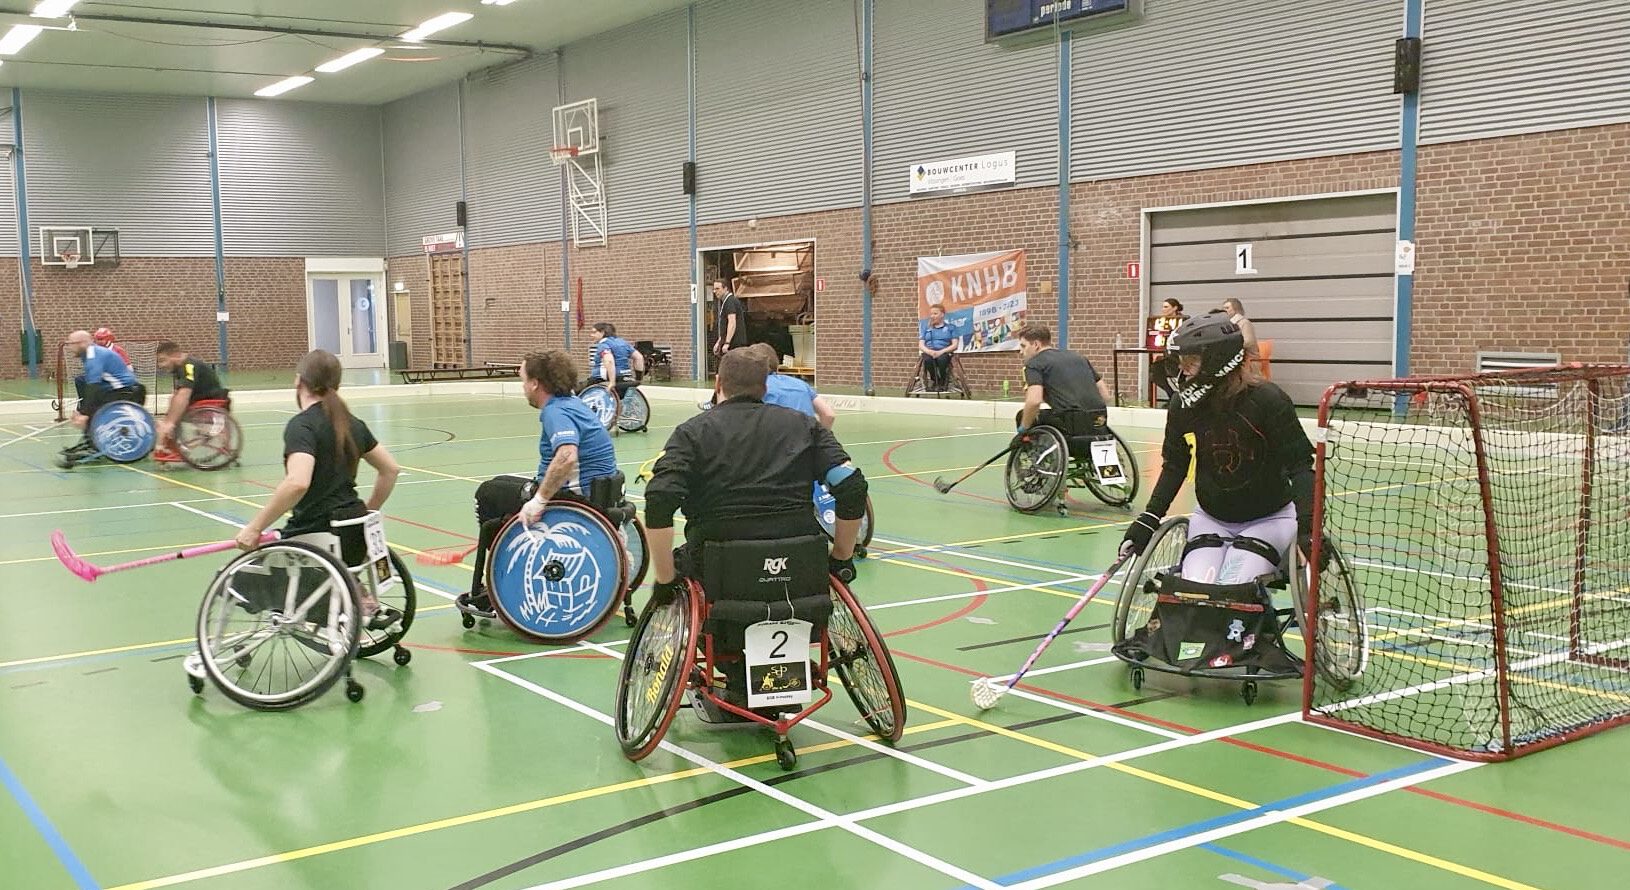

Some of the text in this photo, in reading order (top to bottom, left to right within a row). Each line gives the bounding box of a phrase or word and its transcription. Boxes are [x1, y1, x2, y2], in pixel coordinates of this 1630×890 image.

[927, 159, 1009, 176] BOUWCENTER Logus
[1239, 248, 1247, 268] 1
[951, 261, 1019, 303] KNHB
[1101, 449, 1108, 464] 7
[763, 557, 789, 575] RGK
[769, 630, 789, 659] 2
